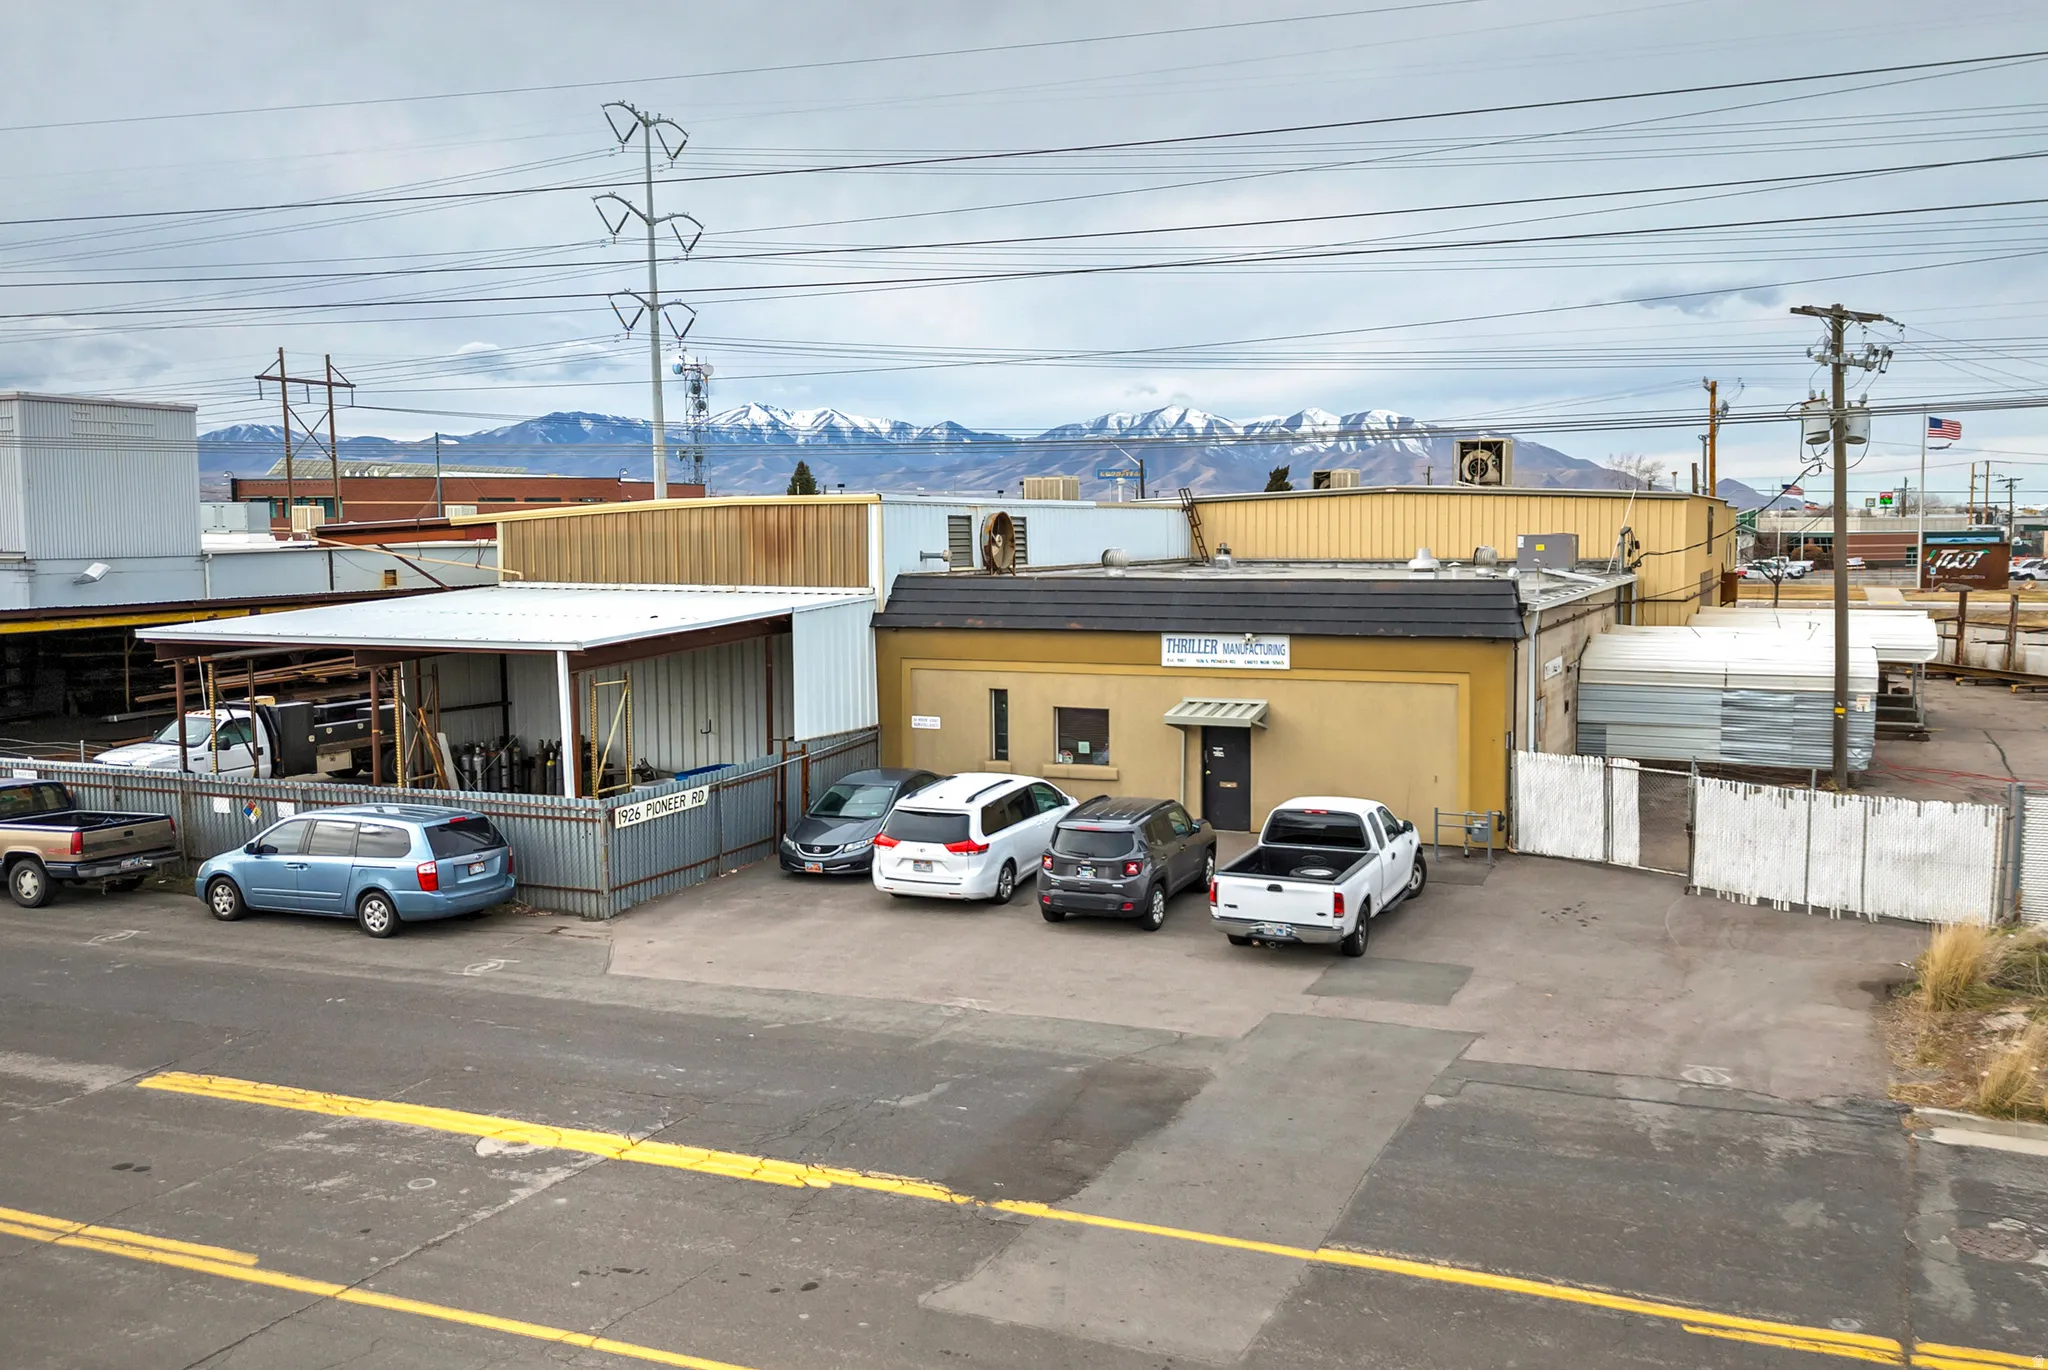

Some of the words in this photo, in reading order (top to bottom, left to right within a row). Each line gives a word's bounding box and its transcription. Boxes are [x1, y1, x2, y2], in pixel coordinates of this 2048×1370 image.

[1166, 638, 1218, 654] THRILLER
[1222, 643, 1286, 656] MANUFACTURING
[618, 807, 641, 825] 1926
[646, 794, 686, 817] PIONEER
